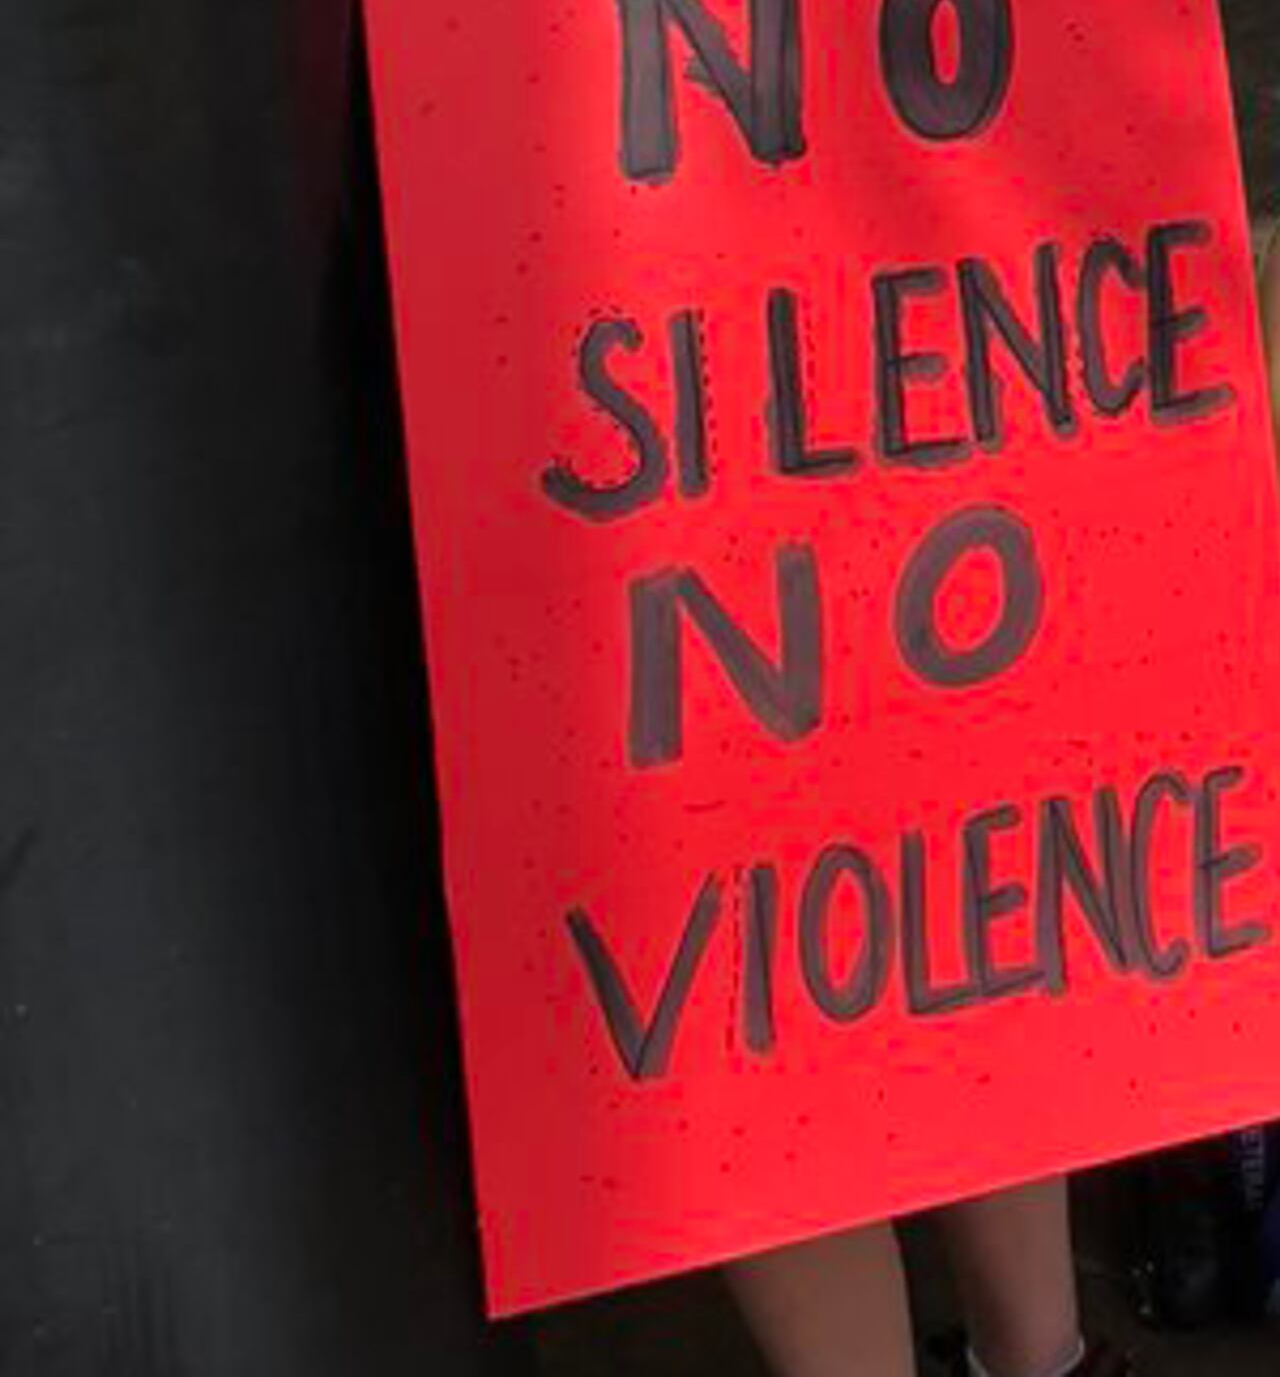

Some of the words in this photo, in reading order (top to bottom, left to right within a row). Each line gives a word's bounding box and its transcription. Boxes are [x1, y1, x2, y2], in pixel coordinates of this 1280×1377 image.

[540, 221, 1239, 521] SILENCE
[626, 503, 1046, 768] NO
[565, 766, 1270, 1083] VIOLENCE
